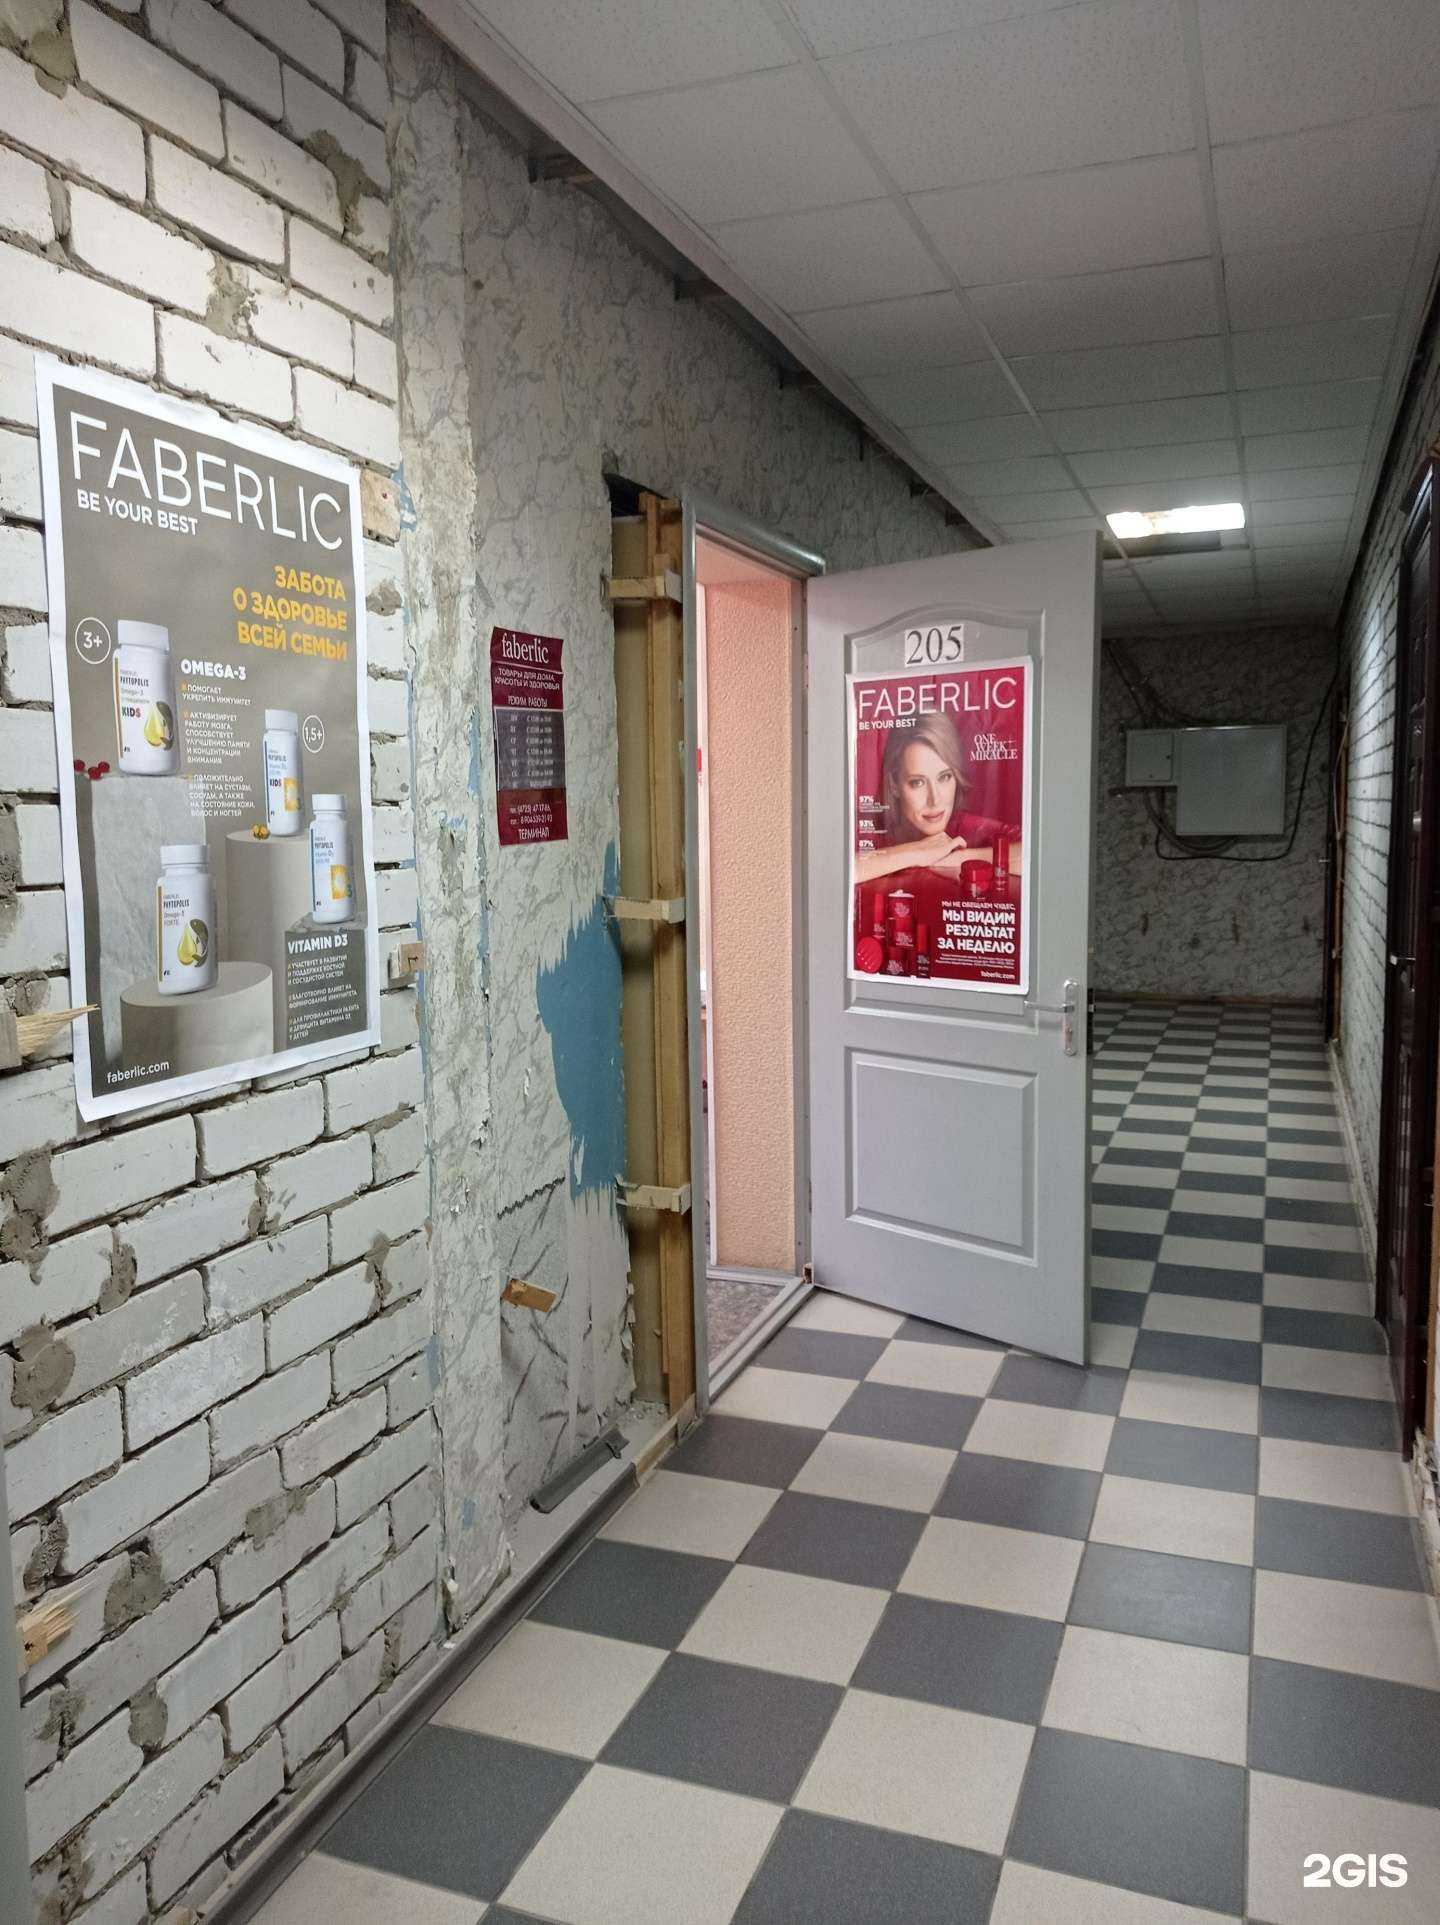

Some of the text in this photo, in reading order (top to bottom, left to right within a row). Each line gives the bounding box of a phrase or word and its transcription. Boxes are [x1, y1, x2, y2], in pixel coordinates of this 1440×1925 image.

[70, 411, 343, 550] FABERLIC
[77, 488, 198, 536] BE YOUR BEST
[274, 565, 347, 601] ЗАБОТА
[232, 587, 347, 632] О ЗДОРОВЬЕ
[83, 631, 103, 649] 3+
[237, 619, 347, 662] ВСЕЙ СЕМЬИ
[502, 632, 550, 664] faberlic
[906, 625, 962, 665] 205
[181, 658, 246, 681] OMEGA-3
[498, 668, 523, 678] ТОВАРЫ
[187, 684, 221, 694] ПОМОГАЕТ
[495, 676, 523, 687] КРАСОТЫ
[529, 681, 560, 691] ЗДОРОВЬЯ
[858, 677, 1017, 719] FABERLIC
[122, 706, 141, 718] KIDS
[858, 717, 917, 731] BE YOUR BEST
[185, 728, 234, 740] СПОСОБСТВУЕТ
[304, 726, 323, 743] 1,5+
[974, 733, 998, 744] ONE
[969, 749, 1018, 761] MIRACLE
[975, 741, 1008, 752] WEEK
[518, 827, 550, 840] ТЕРМИНАЛ
[961, 901, 993, 910] ОБЕЩАЕМ
[943, 909, 1016, 925] МЫ ВИДИМ
[945, 923, 1016, 940] РЕЗУЛЬТАТ
[287, 931, 348, 955] VITAMIN D3
[937, 937, 1016, 955] ЗА НЕДЕЛЮ
[107, 1061, 169, 1084] faberlic.com
